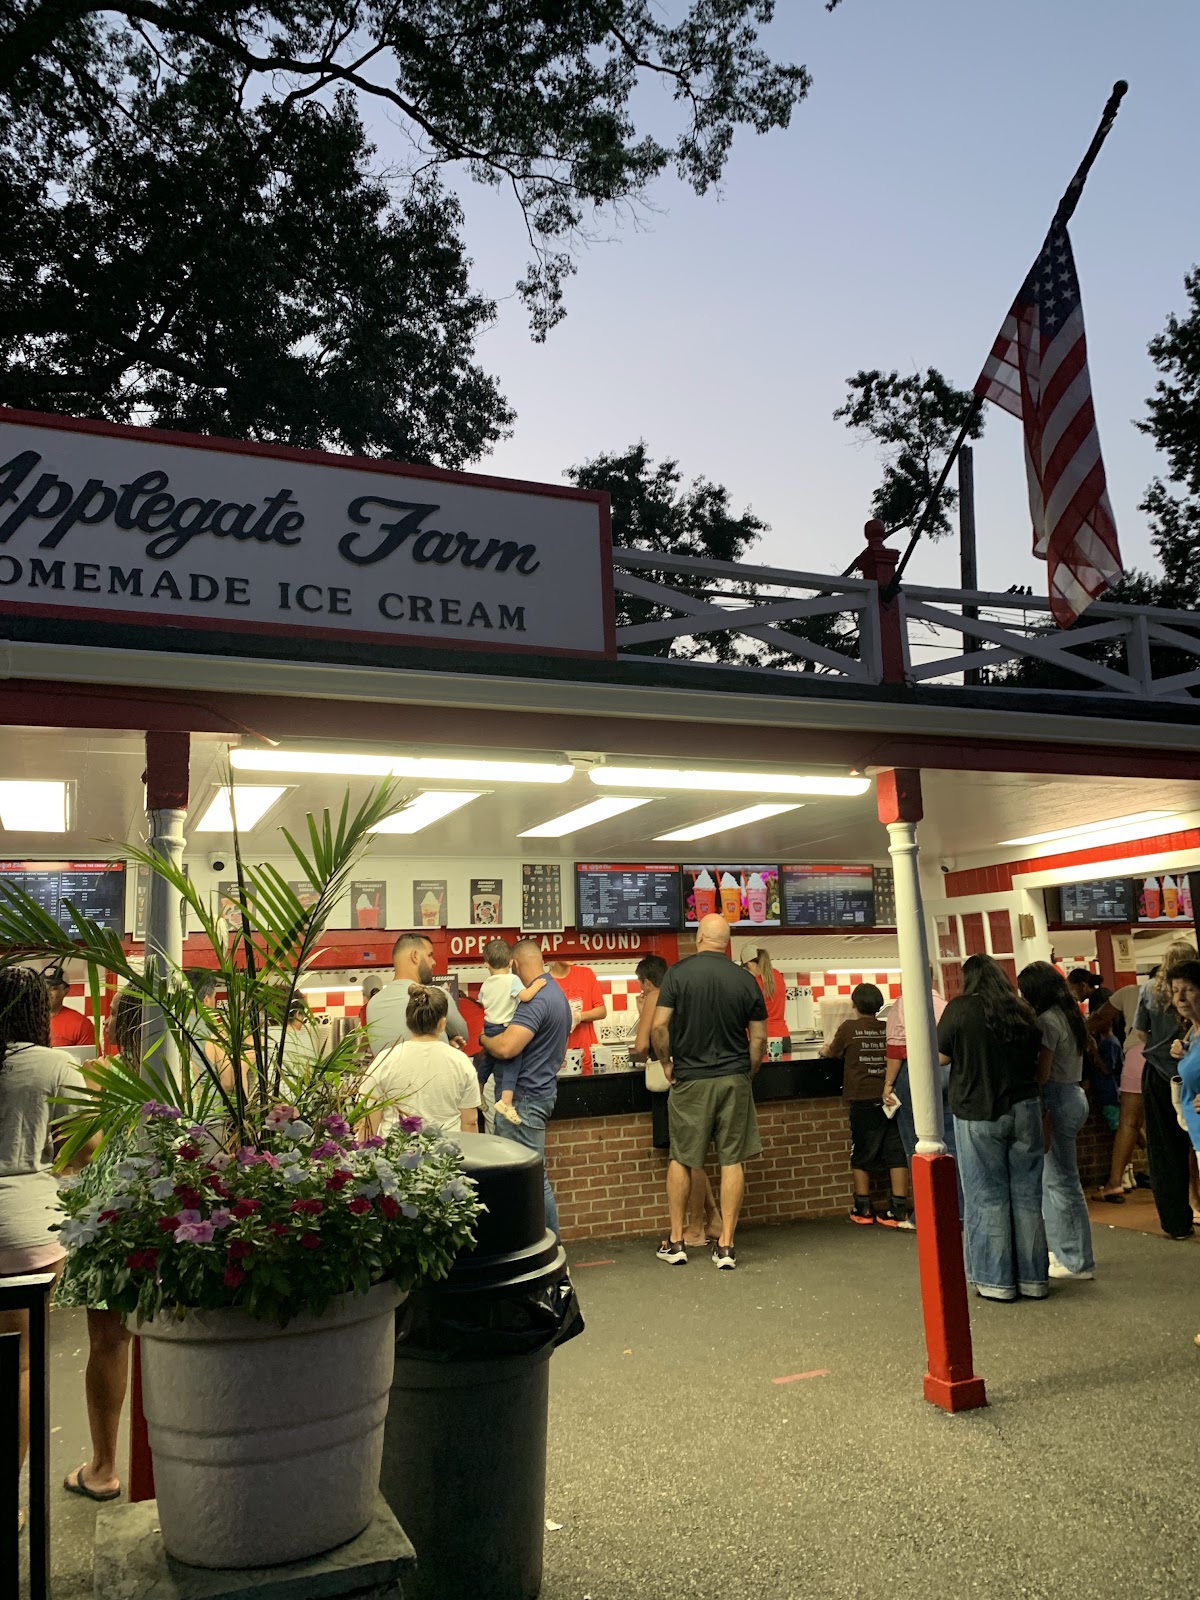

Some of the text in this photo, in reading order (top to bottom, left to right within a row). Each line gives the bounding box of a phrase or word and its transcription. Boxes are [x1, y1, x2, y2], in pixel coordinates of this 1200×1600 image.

[0, 450, 540, 574] Applegate Farm
[278, 582, 352, 616] ICE
[378, 592, 526, 631] CREAM
[451, 935, 501, 955] OPE
